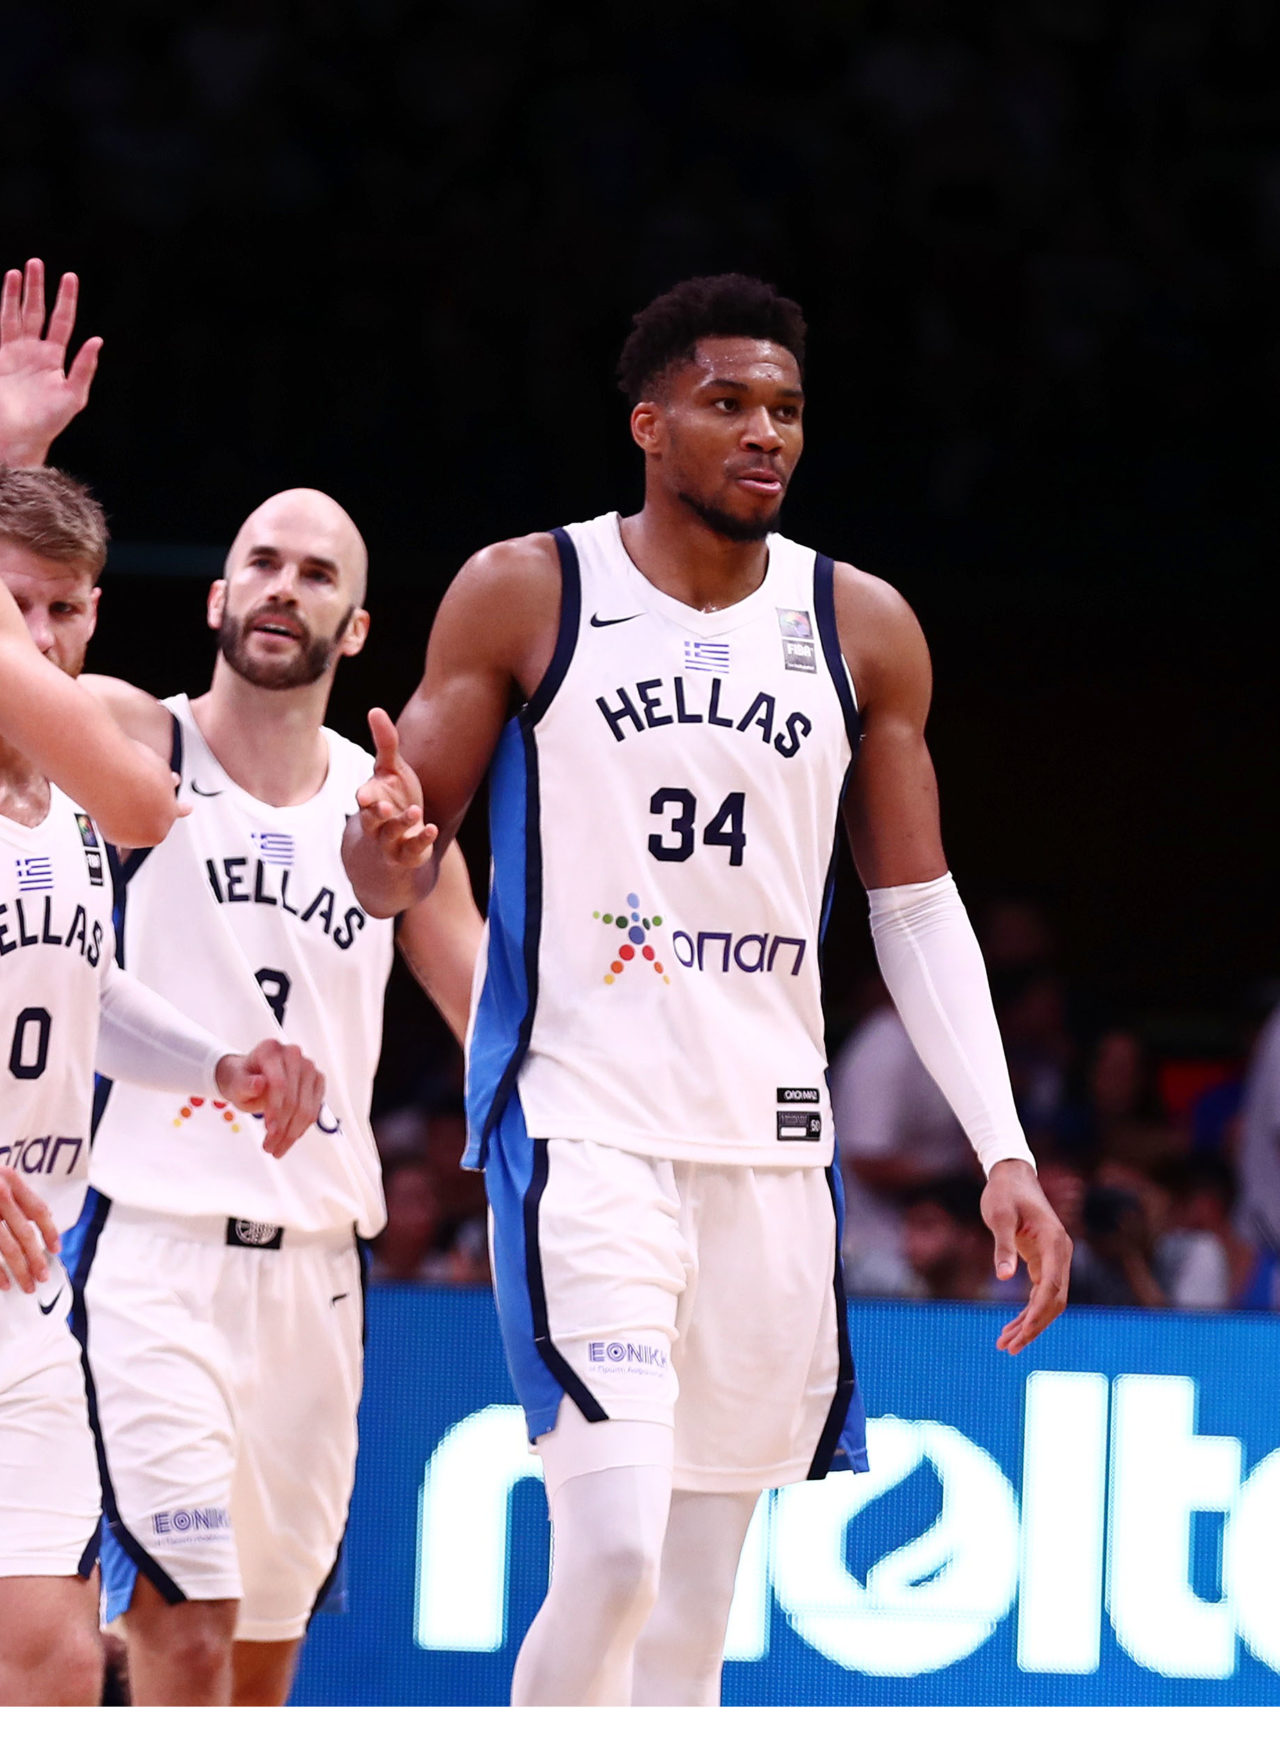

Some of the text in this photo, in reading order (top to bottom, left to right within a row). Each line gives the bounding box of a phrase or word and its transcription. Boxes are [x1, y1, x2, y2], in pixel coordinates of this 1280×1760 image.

[596, 676, 811, 759] HELLAS
[648, 787, 746, 867] 34
[8, 1006, 52, 1079] 0
